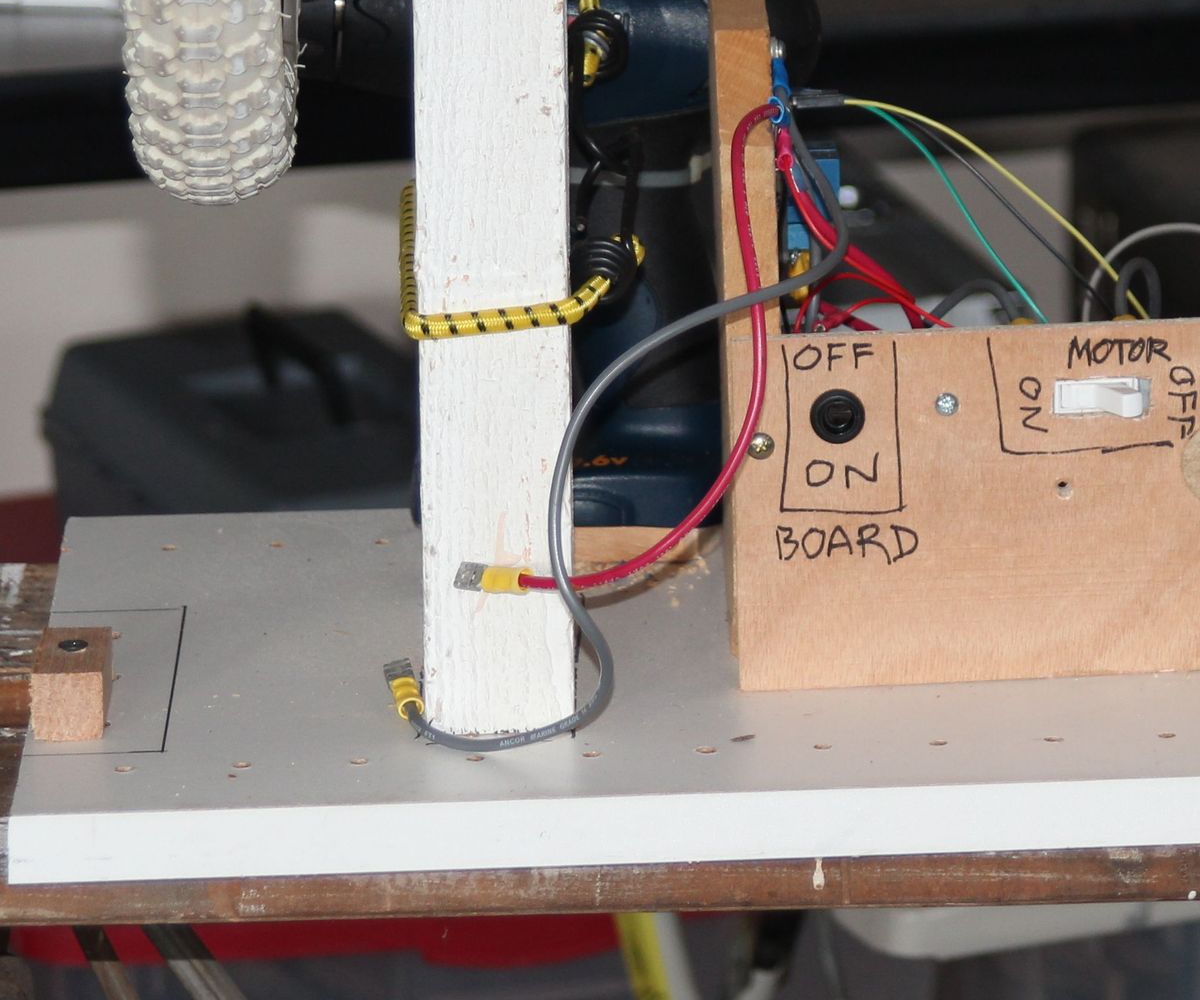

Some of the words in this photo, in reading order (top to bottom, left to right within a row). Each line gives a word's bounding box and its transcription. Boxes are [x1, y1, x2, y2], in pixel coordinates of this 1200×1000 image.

[793, 343, 874, 371] OFF
[1067, 335, 1172, 369] MOTOR
[1019, 376, 1049, 434] ON
[1167, 365, 1198, 440] OFF
[806, 452, 880, 489] ON
[776, 523, 919, 565] BOARD
[499, 735, 526, 748] ANCOR
[530, 727, 557, 741] MARINE
[559, 715, 580, 730] GRADE
